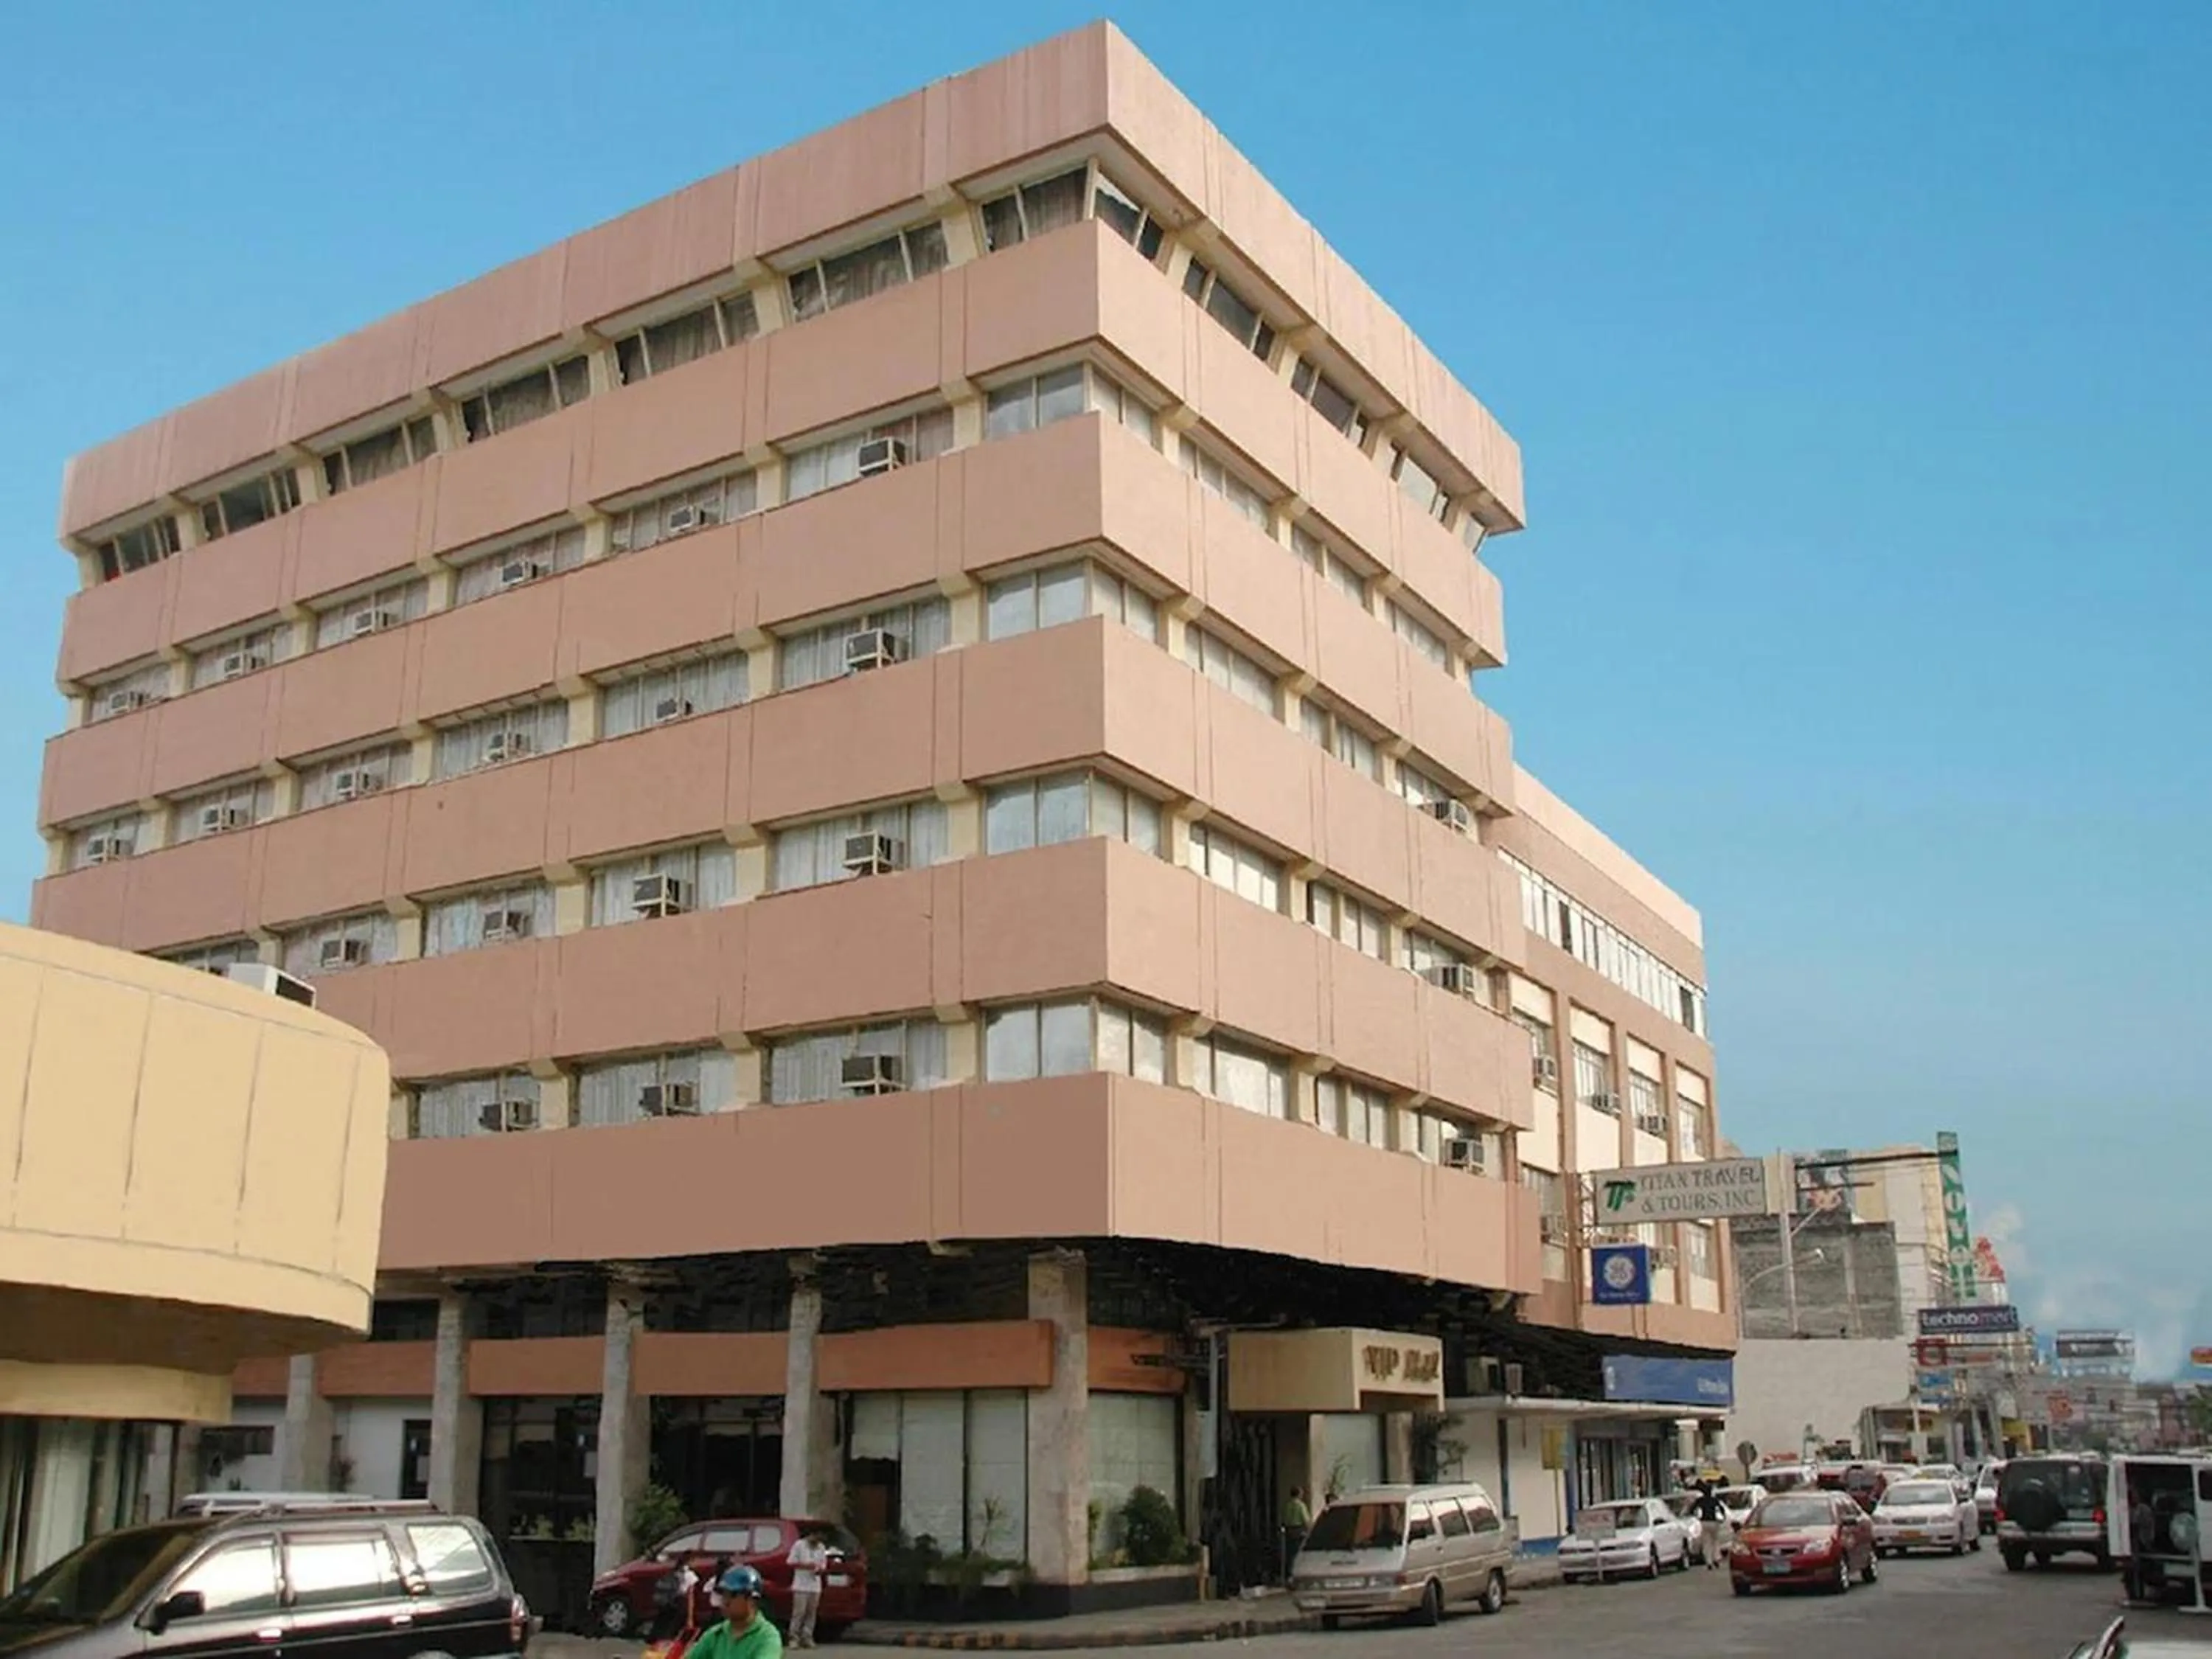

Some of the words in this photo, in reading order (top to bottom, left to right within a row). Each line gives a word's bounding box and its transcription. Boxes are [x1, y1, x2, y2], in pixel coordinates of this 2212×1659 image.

[1638, 1172, 1688, 1191] TITAN
[1691, 1164, 1760, 1187] TRAVEL
[1641, 1197, 1654, 1214] &
[1725, 1189, 1761, 1208] INC.
